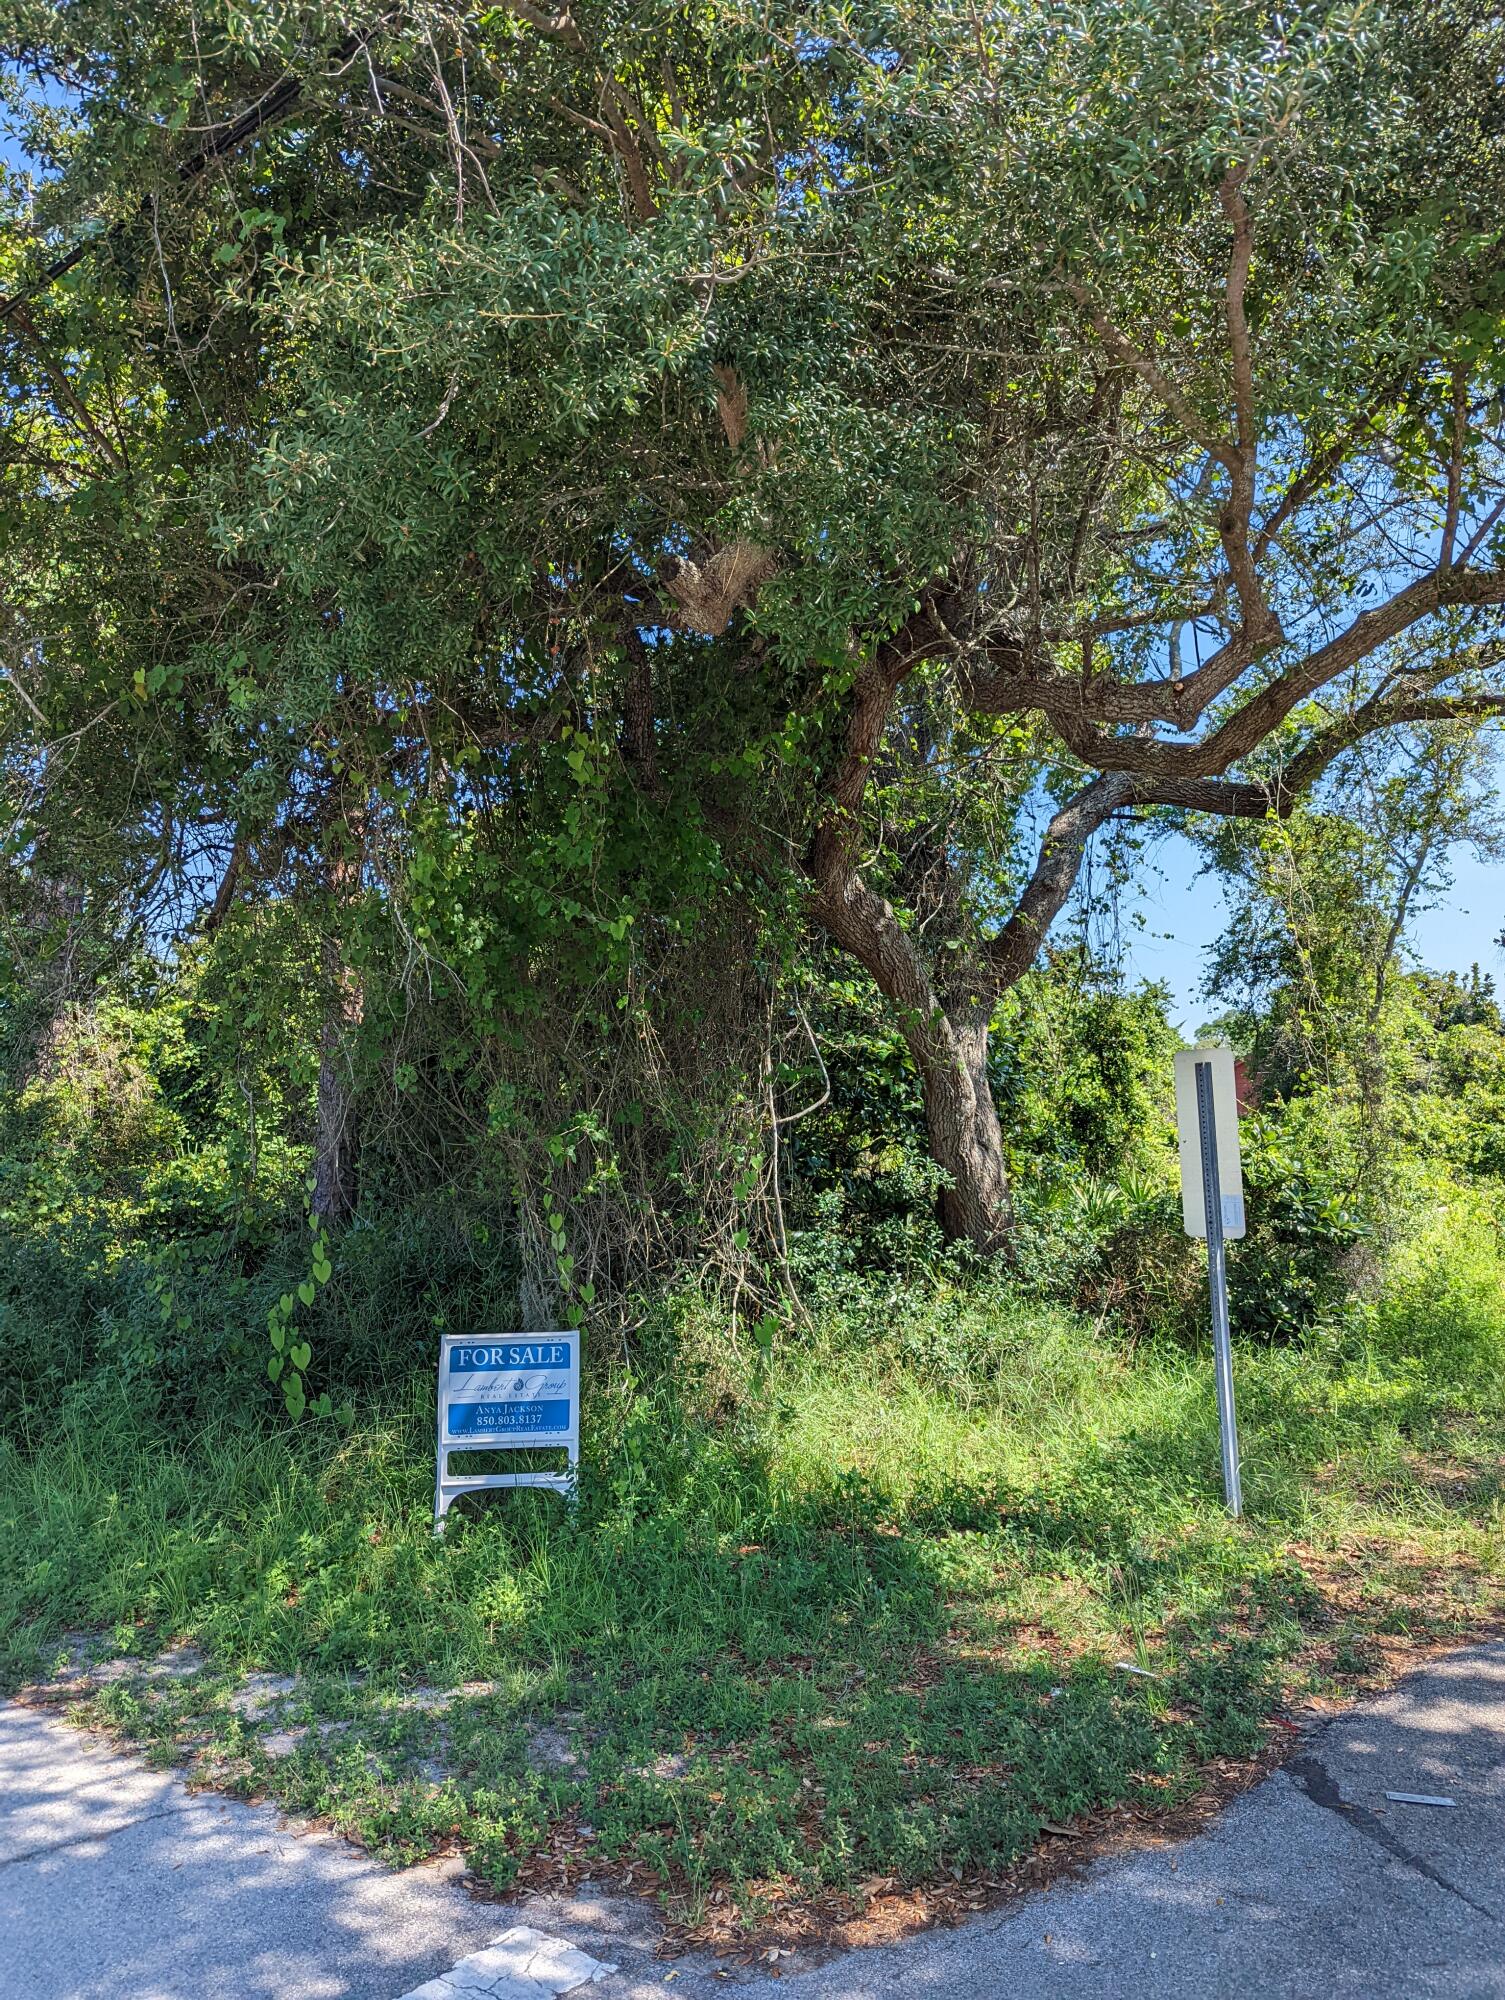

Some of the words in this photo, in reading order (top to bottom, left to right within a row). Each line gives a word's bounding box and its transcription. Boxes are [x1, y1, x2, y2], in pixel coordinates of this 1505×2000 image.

[458, 1348, 504, 1366] FOR
[509, 1346, 564, 1364] SALE
[453, 1374, 517, 1392] Lambert
[525, 1374, 567, 1398] Group
[476, 1414, 542, 1426] 850.803.8137
